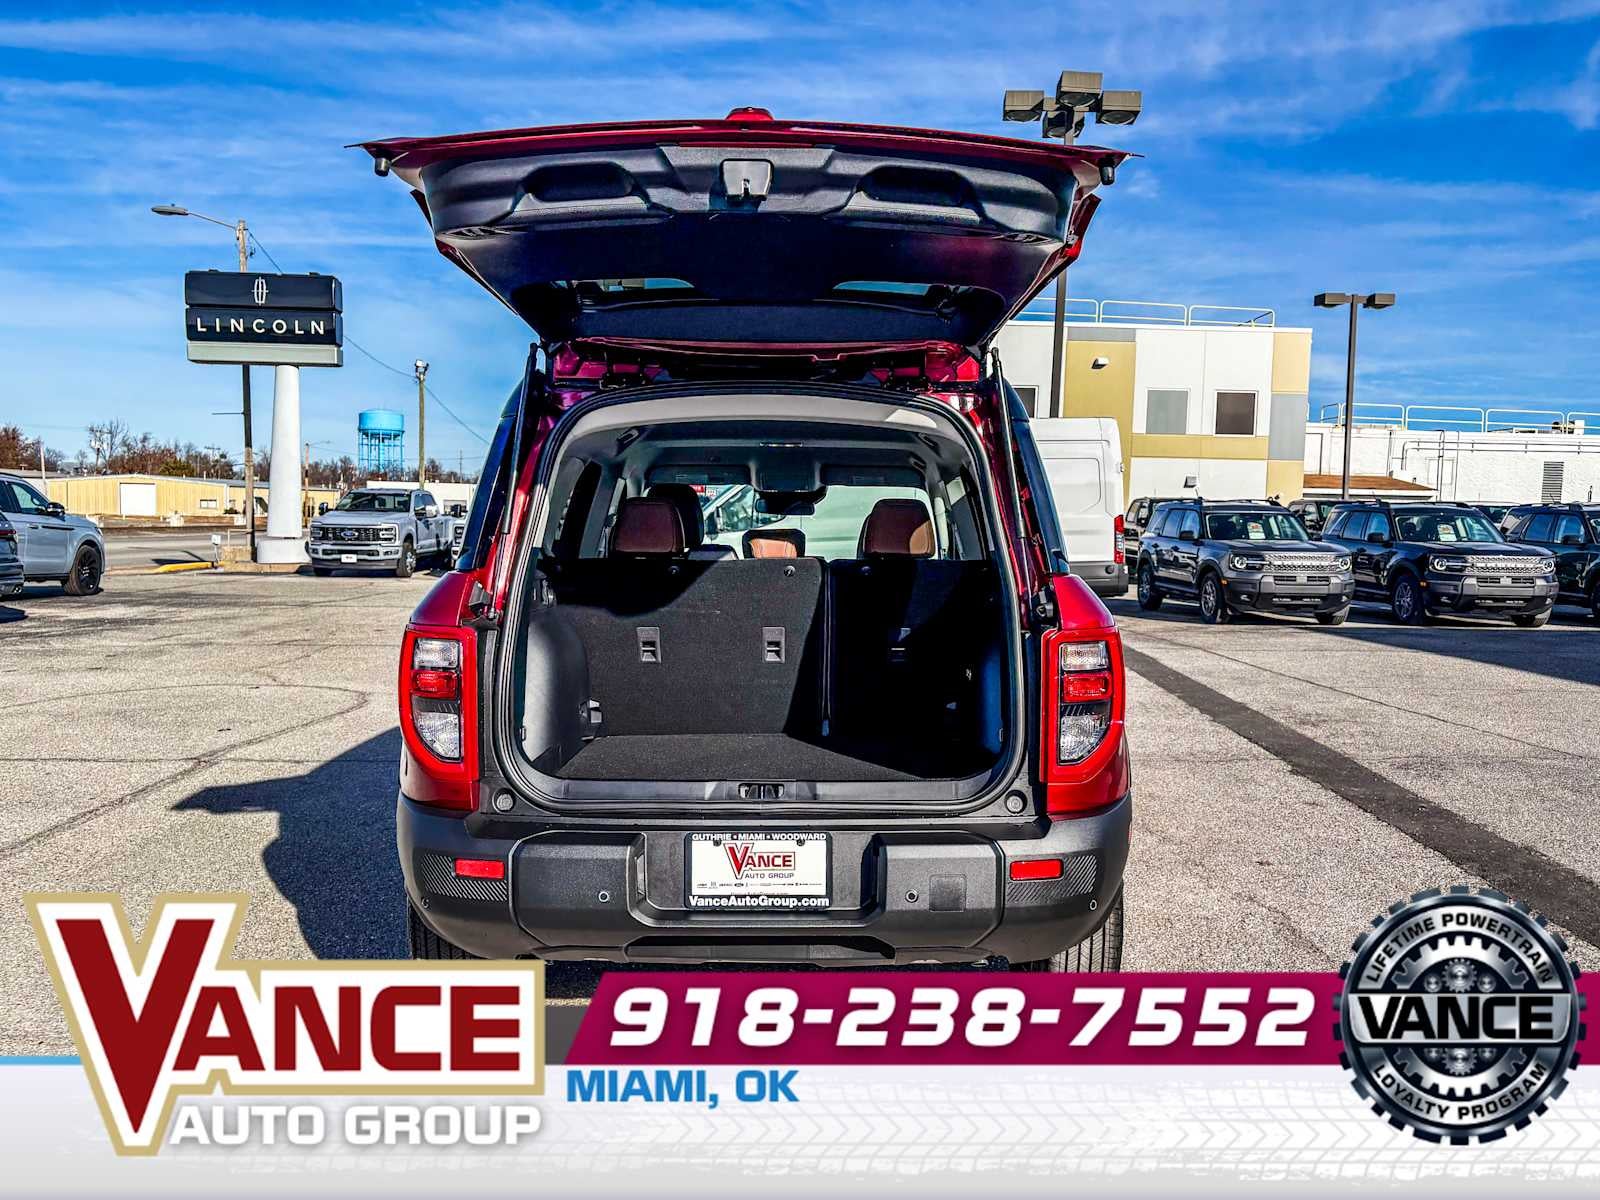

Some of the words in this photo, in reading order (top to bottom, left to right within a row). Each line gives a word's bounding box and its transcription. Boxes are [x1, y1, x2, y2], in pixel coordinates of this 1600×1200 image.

[196, 317, 325, 335] LINCOLN
[692, 833, 732, 841] GUTHRIE
[728, 846, 793, 874] VANCE
[689, 895, 829, 908] VanceAutoGroup.com
